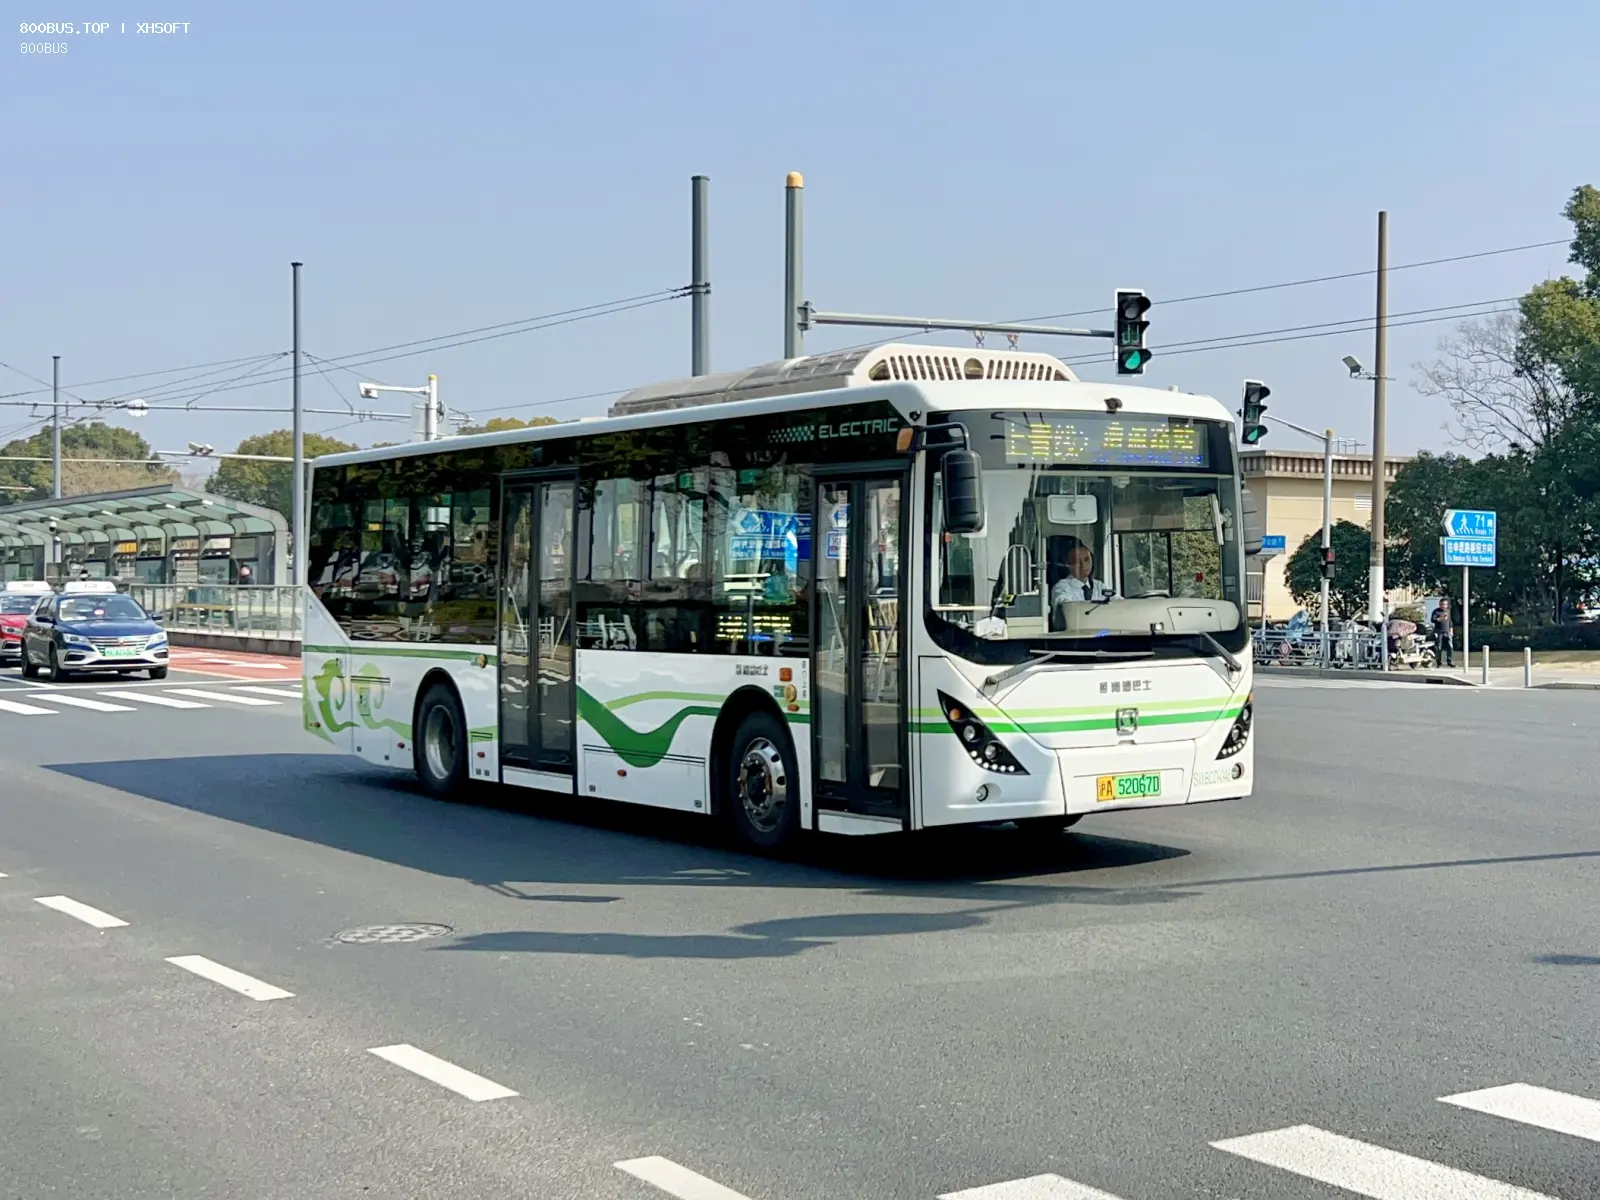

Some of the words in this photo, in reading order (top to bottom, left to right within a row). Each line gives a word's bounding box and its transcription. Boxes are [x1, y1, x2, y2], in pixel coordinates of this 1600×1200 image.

[819, 417, 899, 439] ELECTRIC
[1475, 514, 1485, 528] 71
[1119, 776, 1160, 795] 52067D
